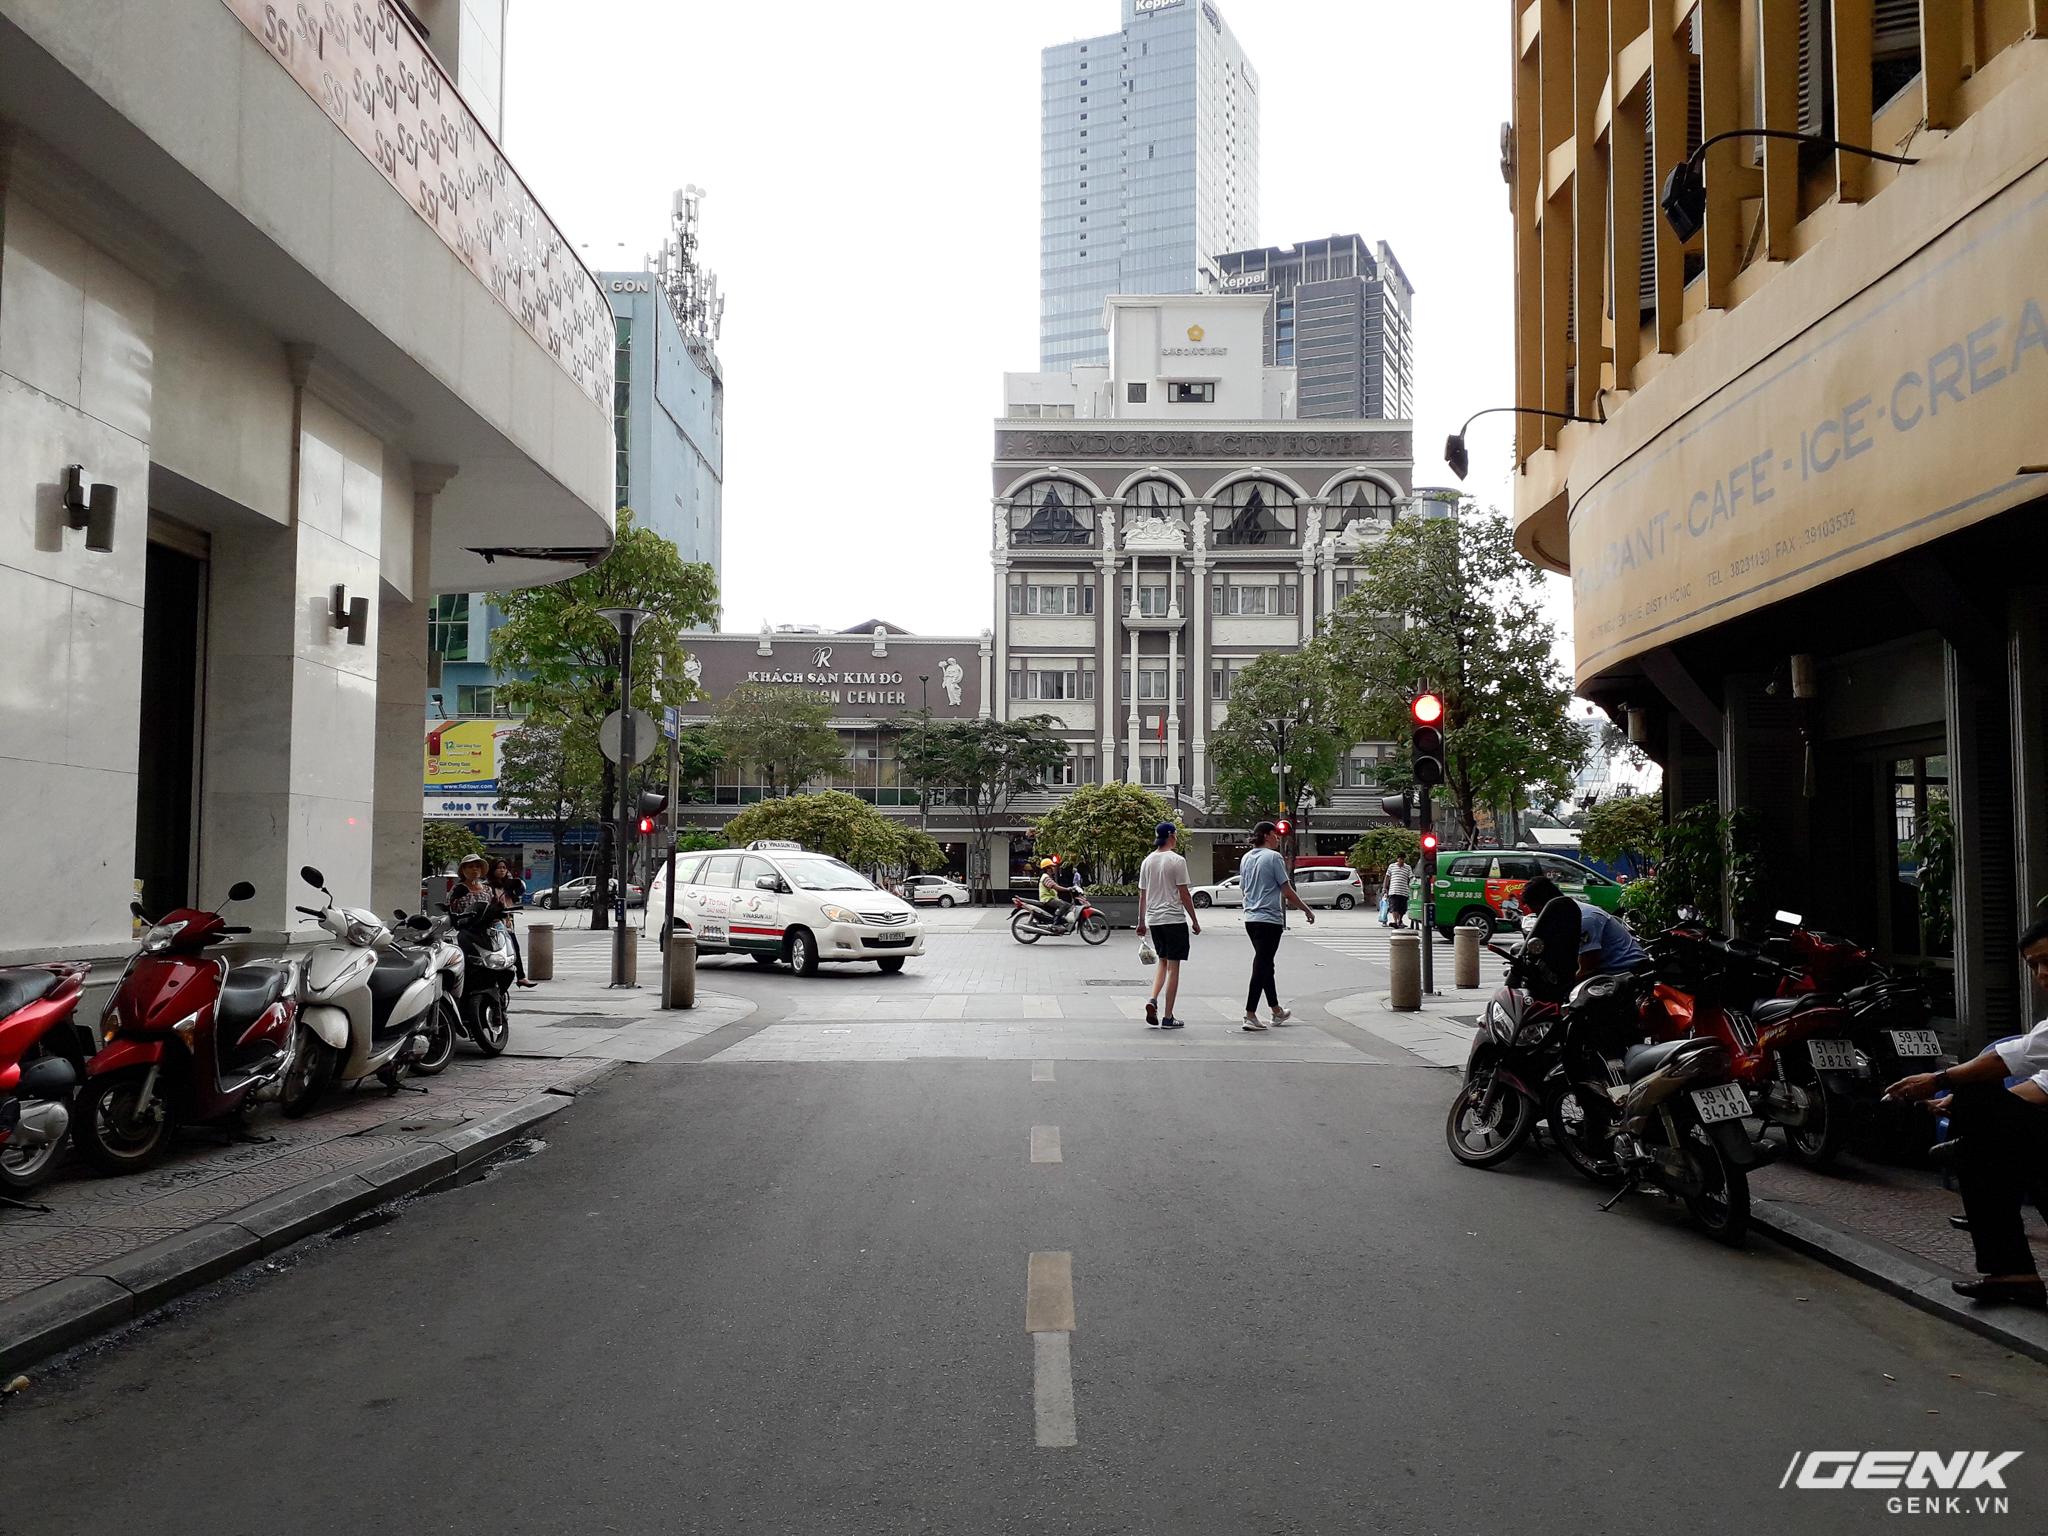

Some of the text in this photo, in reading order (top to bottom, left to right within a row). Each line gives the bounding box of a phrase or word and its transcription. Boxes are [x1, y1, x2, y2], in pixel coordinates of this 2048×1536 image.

[1135, 0, 1183, 10] Keppe
[265, 4, 294, 64] SSI
[296, 3, 323, 60] SSI
[324, 1, 350, 56] SSI
[353, 3, 376, 56] SSI
[377, 0, 398, 51] SSI
[353, 67, 375, 120] SSI
[376, 64, 396, 115] SSI
[399, 60, 419, 110] SSI
[421, 57, 440, 105] SSI
[323, 71, 348, 125] SSI
[397, 122, 418, 171] SSI
[420, 119, 439, 165] SSI
[440, 113, 458, 159] SSI
[459, 108, 476, 152] SSI
[375, 129, 396, 179] SSI
[478, 163, 492, 202] SSI
[494, 154, 508, 192] SSI
[419, 180, 438, 225] SSI
[440, 172, 457, 216] SSI
[507, 253, 521, 290] SSI
[562, 271, 574, 304] SSI
[574, 258, 584, 293] SSI
[611, 275, 648, 293] GÒN
[1219, 272, 1266, 289] Keppel
[536, 288, 548, 320] SSI
[549, 277, 561, 311] SSI
[521, 297, 535, 332] SSI
[574, 309, 583, 340] SSI
[584, 300, 595, 330] SSI
[548, 327, 561, 359] SSI
[562, 317, 573, 349] SSI
[573, 355, 583, 384] SSI
[583, 344, 595, 373] SSI
[1134, 435, 1214, 456] ROYAL
[1221, 435, 1279, 455] CITY
[1283, 435, 1370, 456] HOTEL
[747, 668, 804, 683] KHÁCH
[807, 672, 838, 686] SẠN
[843, 672, 876, 684] KIM
[847, 690, 906, 705] CENTER
[444, 741, 455, 749] 12
[427, 758, 440, 775] 5
[442, 801, 472, 811] CÔNG
[476, 803, 489, 811] TY
[486, 822, 511, 842] 17
[1898, 1031, 1931, 1043] 59-V2
[1898, 1043, 1940, 1055] 547.38
[1819, 1054, 1852, 1067] 3826
[1699, 1086, 1736, 1105] 59-V1
[1702, 1100, 1748, 1120] 342.82
